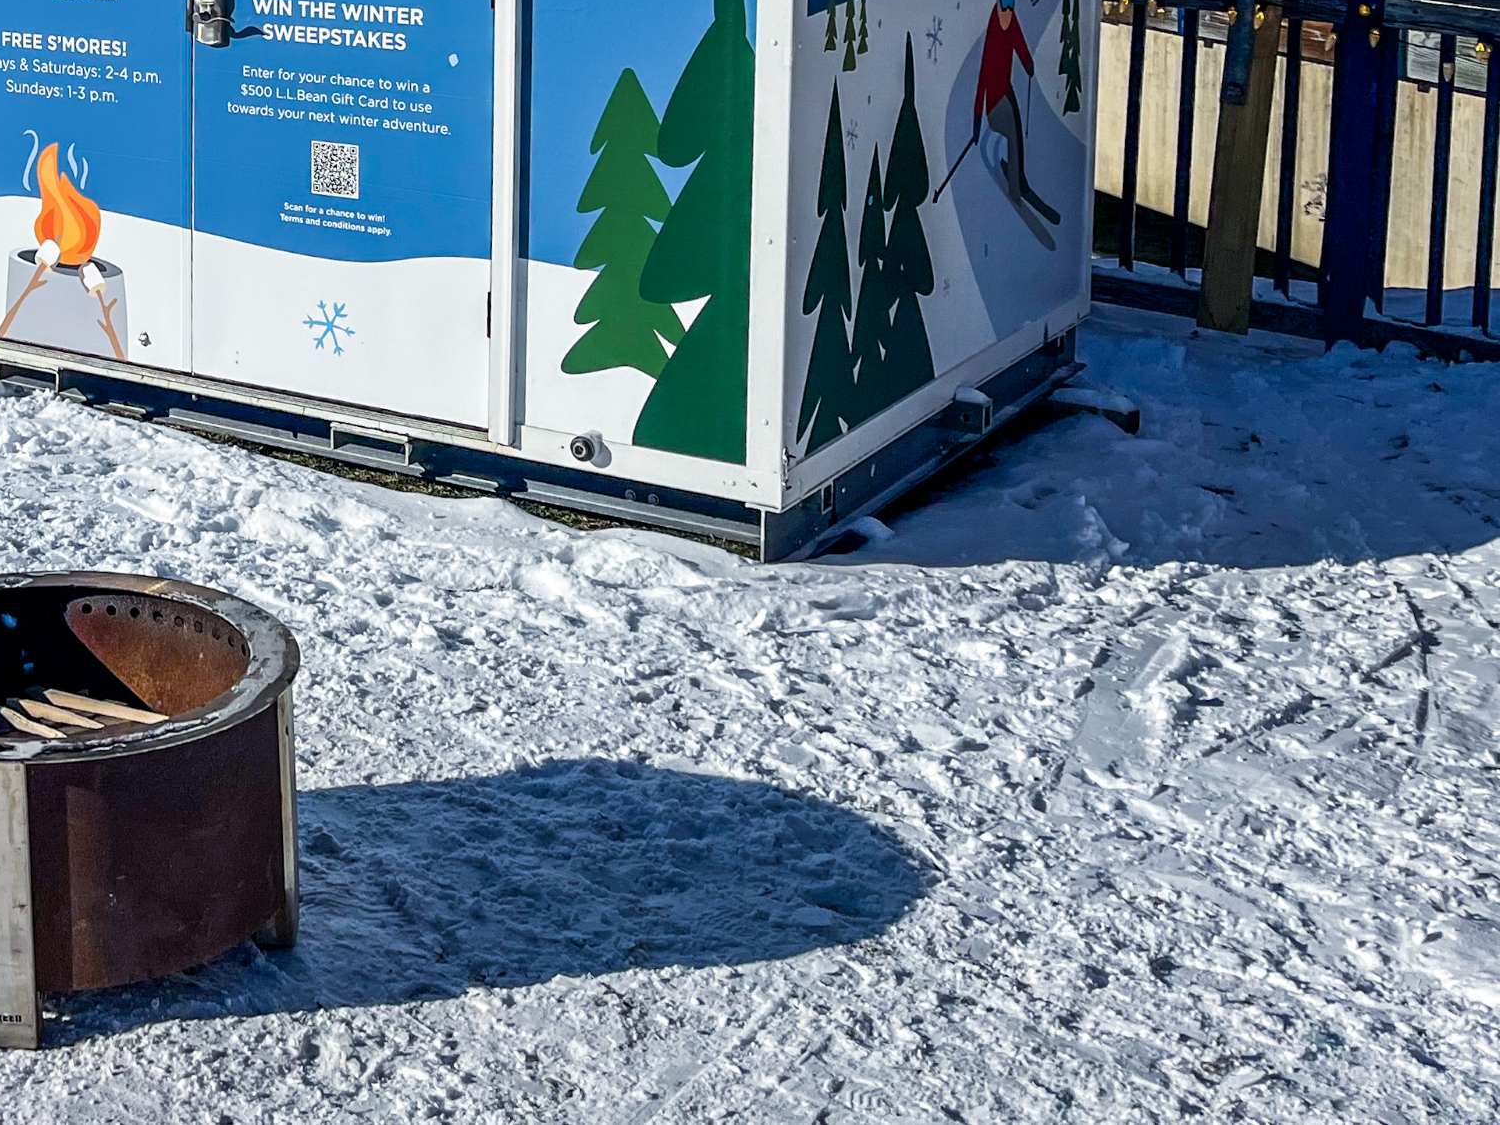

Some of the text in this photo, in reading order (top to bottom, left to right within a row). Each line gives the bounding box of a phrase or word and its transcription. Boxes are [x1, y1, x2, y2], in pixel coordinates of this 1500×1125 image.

[298, 1, 336, 20] THE
[342, 3, 424, 26] WINTER
[1, 31, 128, 57] FREE S'MORES!
[262, 24, 406, 51] SWEEPSTAKES
[19, 58, 28, 70] &
[32, 59, 101, 79] Saturdays:
[105, 65, 128, 80] 2-4
[133, 70, 162, 84] p.m.
[242, 65, 431, 94] Enter for your chance to win a
[6, 79, 118, 104] Sundays: 1-3 p.m.
[241, 83, 432, 114] $500 L.L.Bean Gift Card to use
[227, 102, 452, 136] towards your next winter adventure.
[280, 213, 392, 236] Terms and conditions apply.
[283, 201, 303, 212] Scan
[305, 204, 317, 214] for
[326, 207, 355, 219] chance
[357, 211, 366, 220] to
[367, 212, 386, 222] win!
